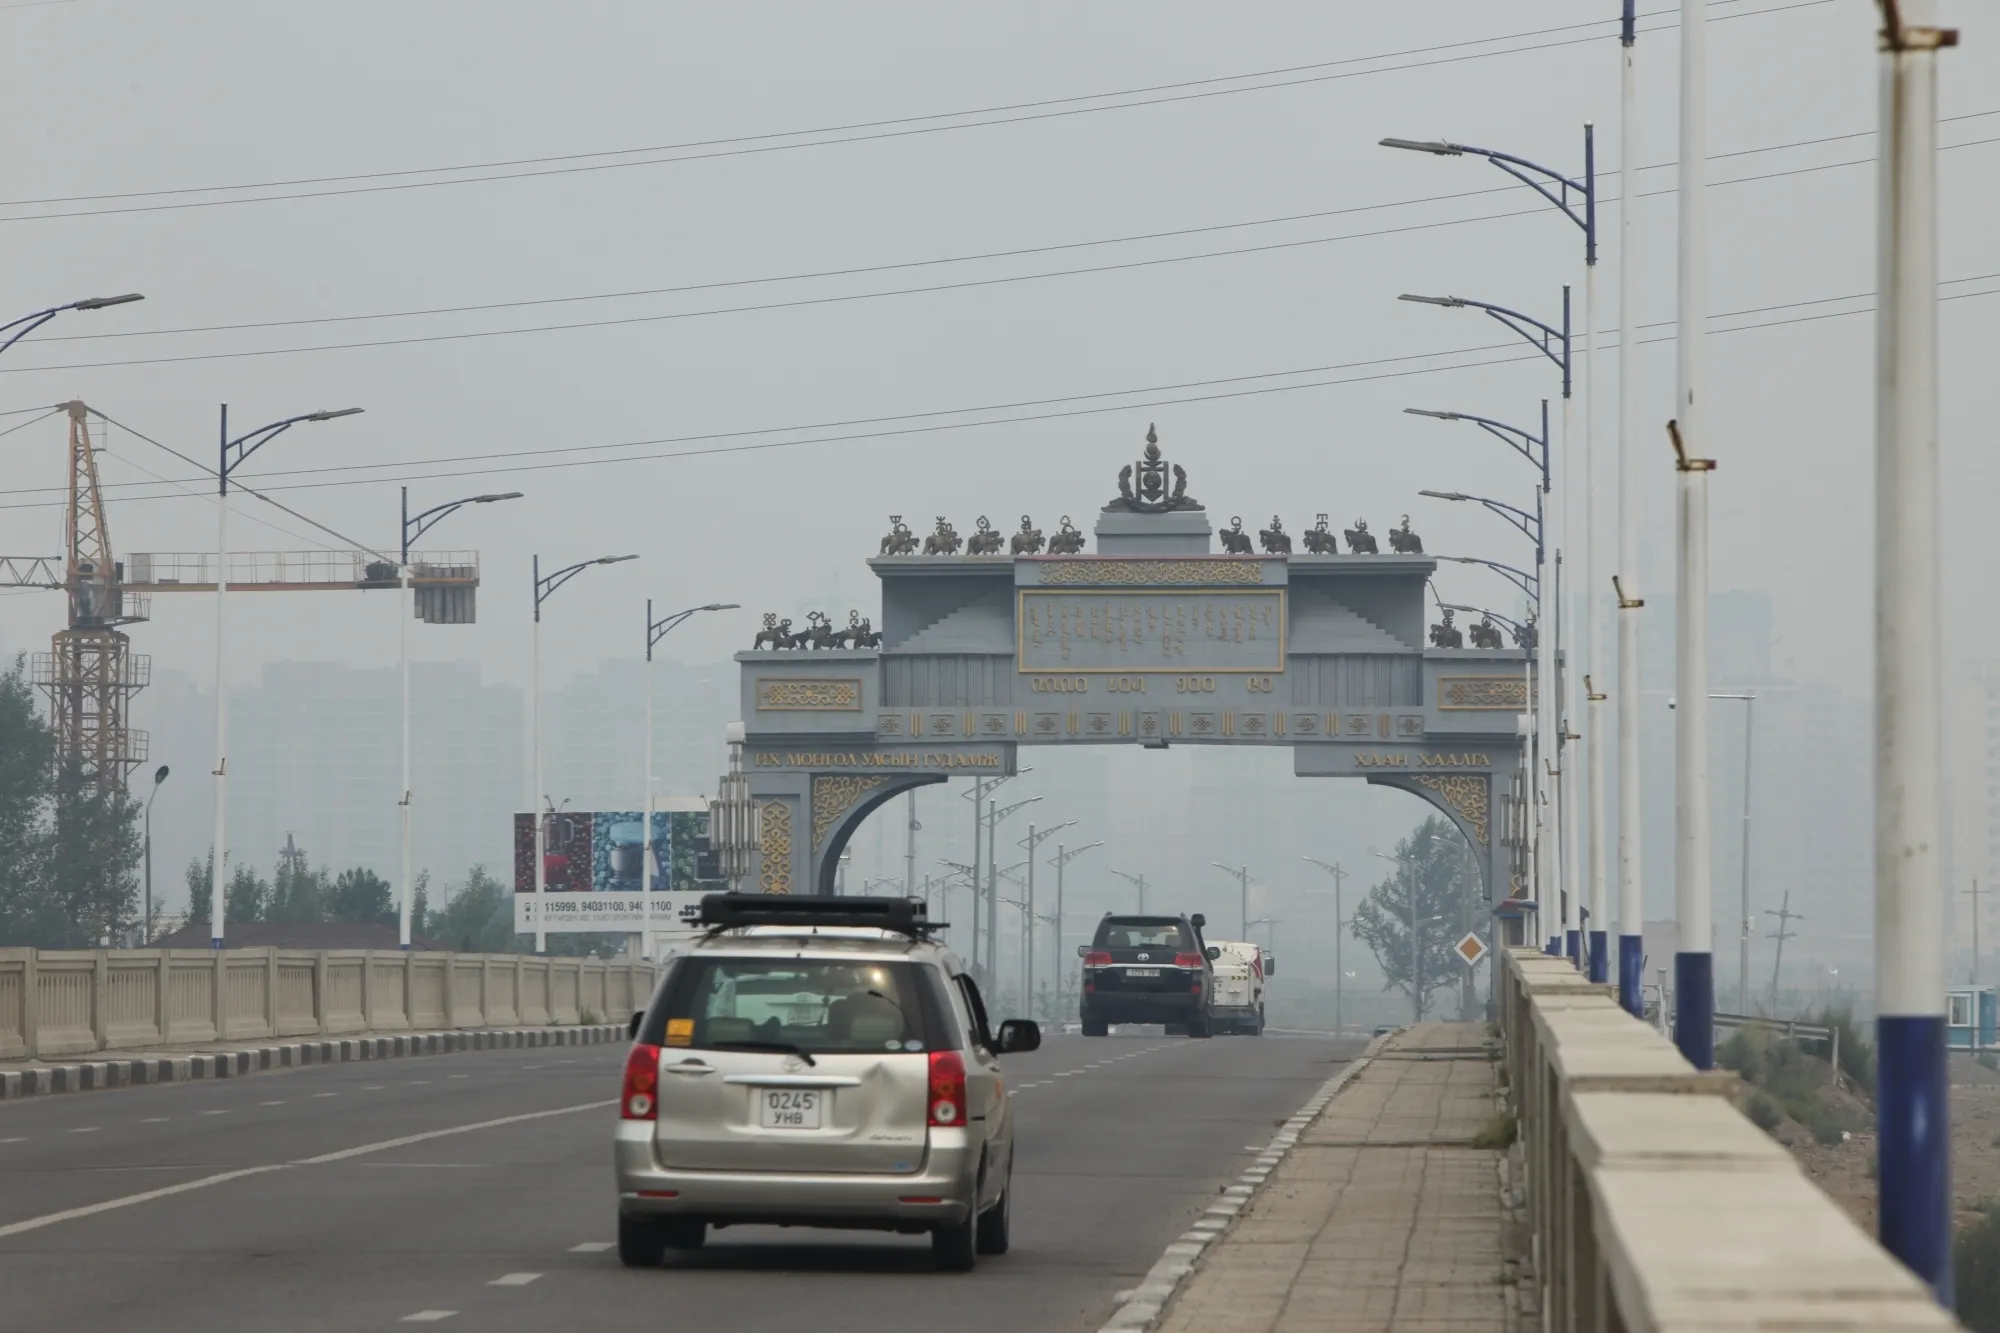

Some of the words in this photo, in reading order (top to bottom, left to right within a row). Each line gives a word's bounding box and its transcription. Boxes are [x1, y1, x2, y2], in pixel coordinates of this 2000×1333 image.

[755, 753, 781, 768] ИХ
[786, 753, 857, 768] МОНГОЛ
[861, 753, 918, 768] УЛСЫН
[923, 753, 999, 768] ГУДАМЖ
[1354, 752, 1409, 767] ХААН
[1417, 752, 1491, 767] ХААЛГА
[629, 901, 672, 912] 9401100
[768, 1092, 814, 1110] 0245
[774, 1112, 804, 1124] УНВ
